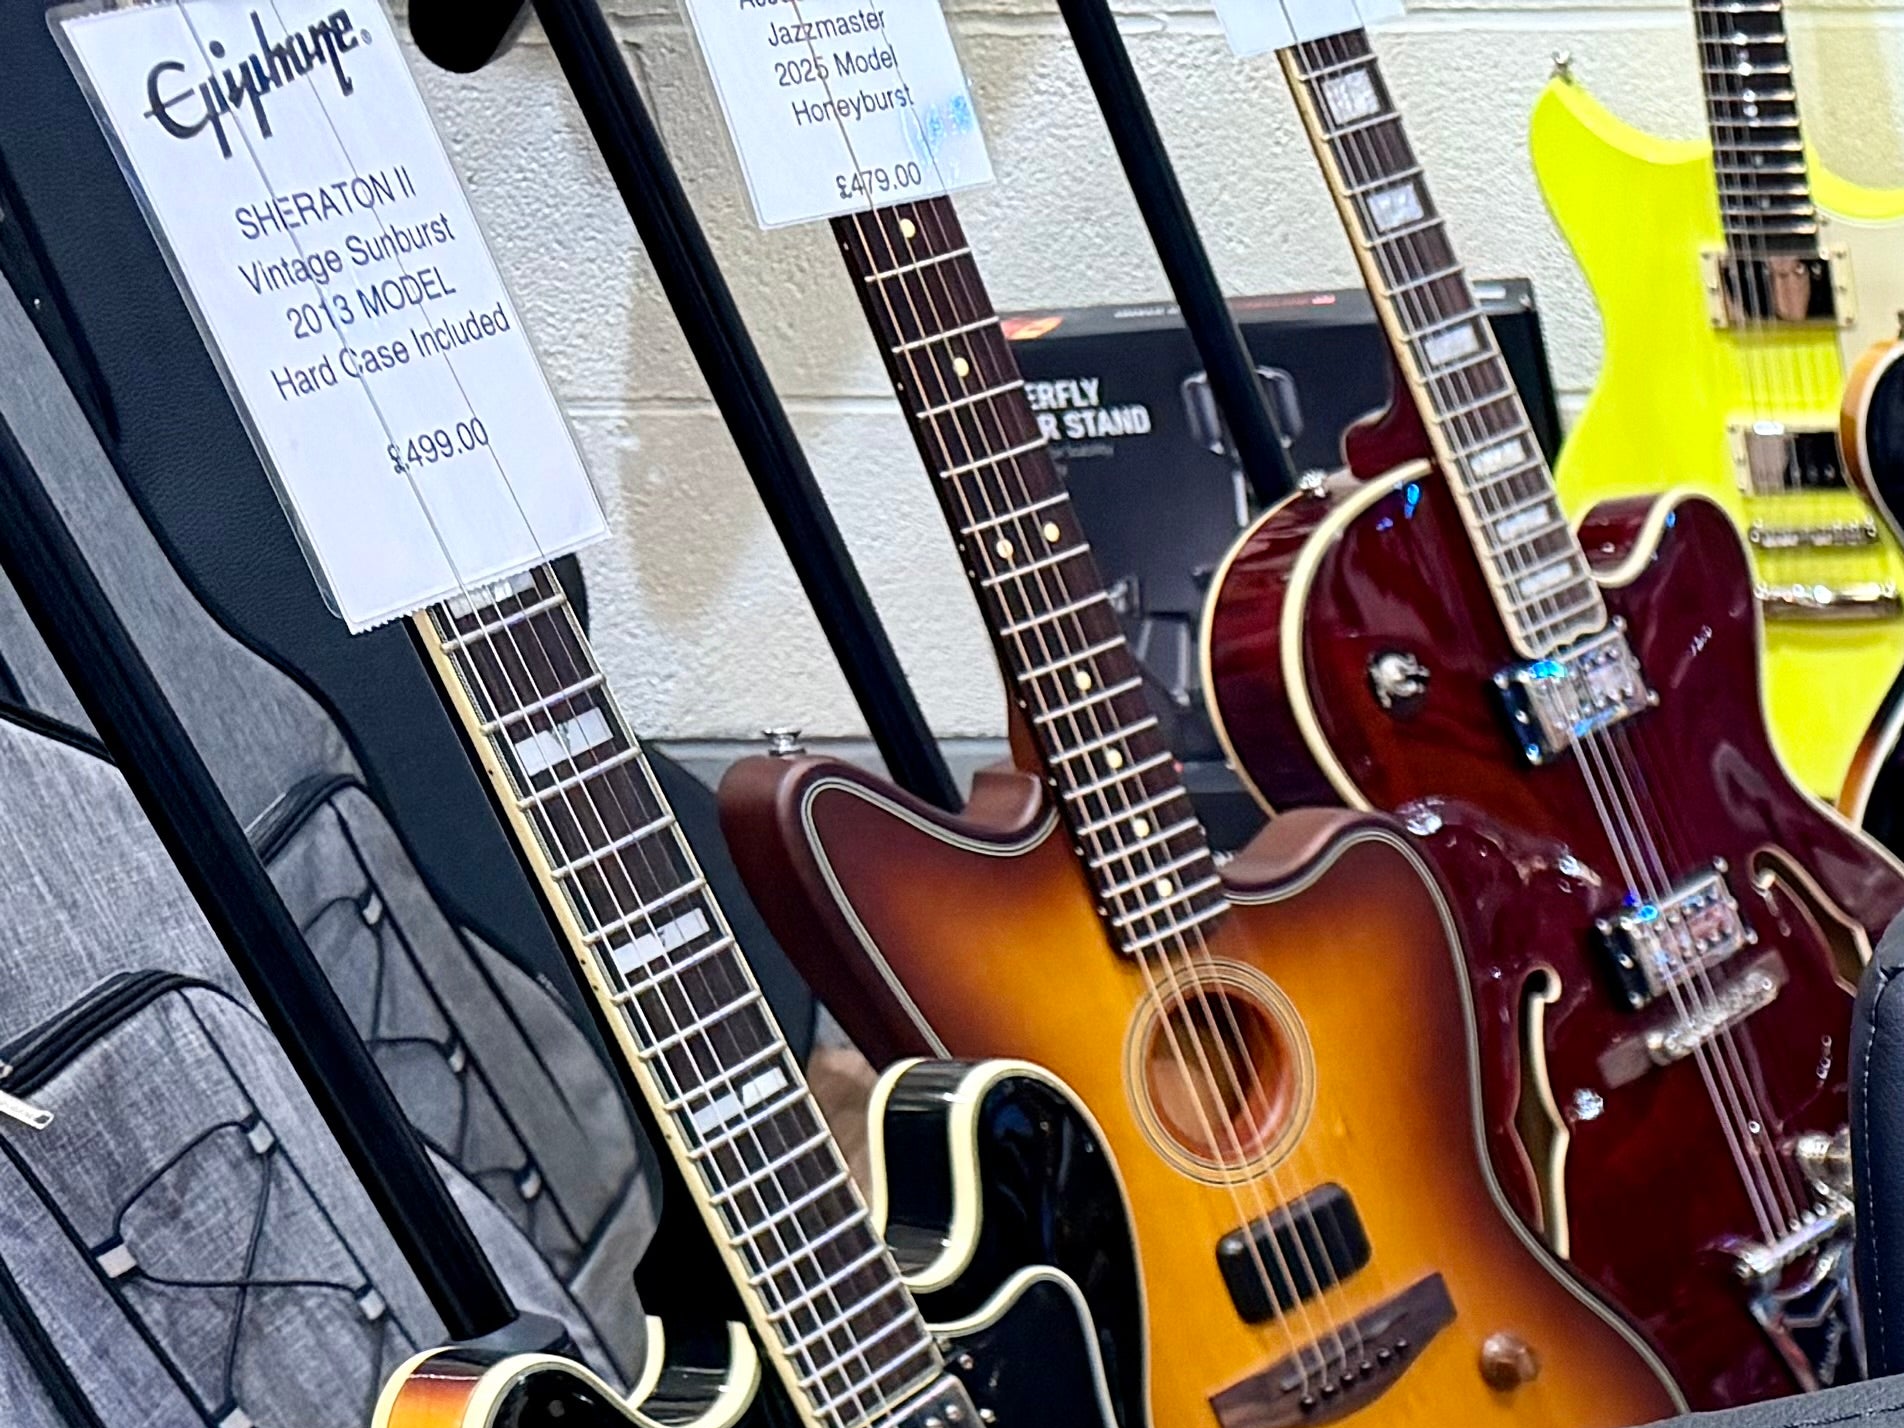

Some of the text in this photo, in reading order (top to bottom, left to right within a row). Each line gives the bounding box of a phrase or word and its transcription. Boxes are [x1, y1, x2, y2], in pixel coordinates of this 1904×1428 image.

[768, 9, 885, 47] Jazzmaster
[775, 44, 899, 86] 2025 Model
[791, 83, 914, 126] Honeyburst
[235, 165, 416, 240] SHERATON II
[835, 161, 922, 200] £479.00
[238, 213, 455, 296] Vintage Sunburst
[286, 267, 456, 339] 2013 MODEL
[271, 302, 511, 401] Hard Case Included
[387, 417, 489, 475] £499.00
[1063, 404, 1151, 439] STAND
